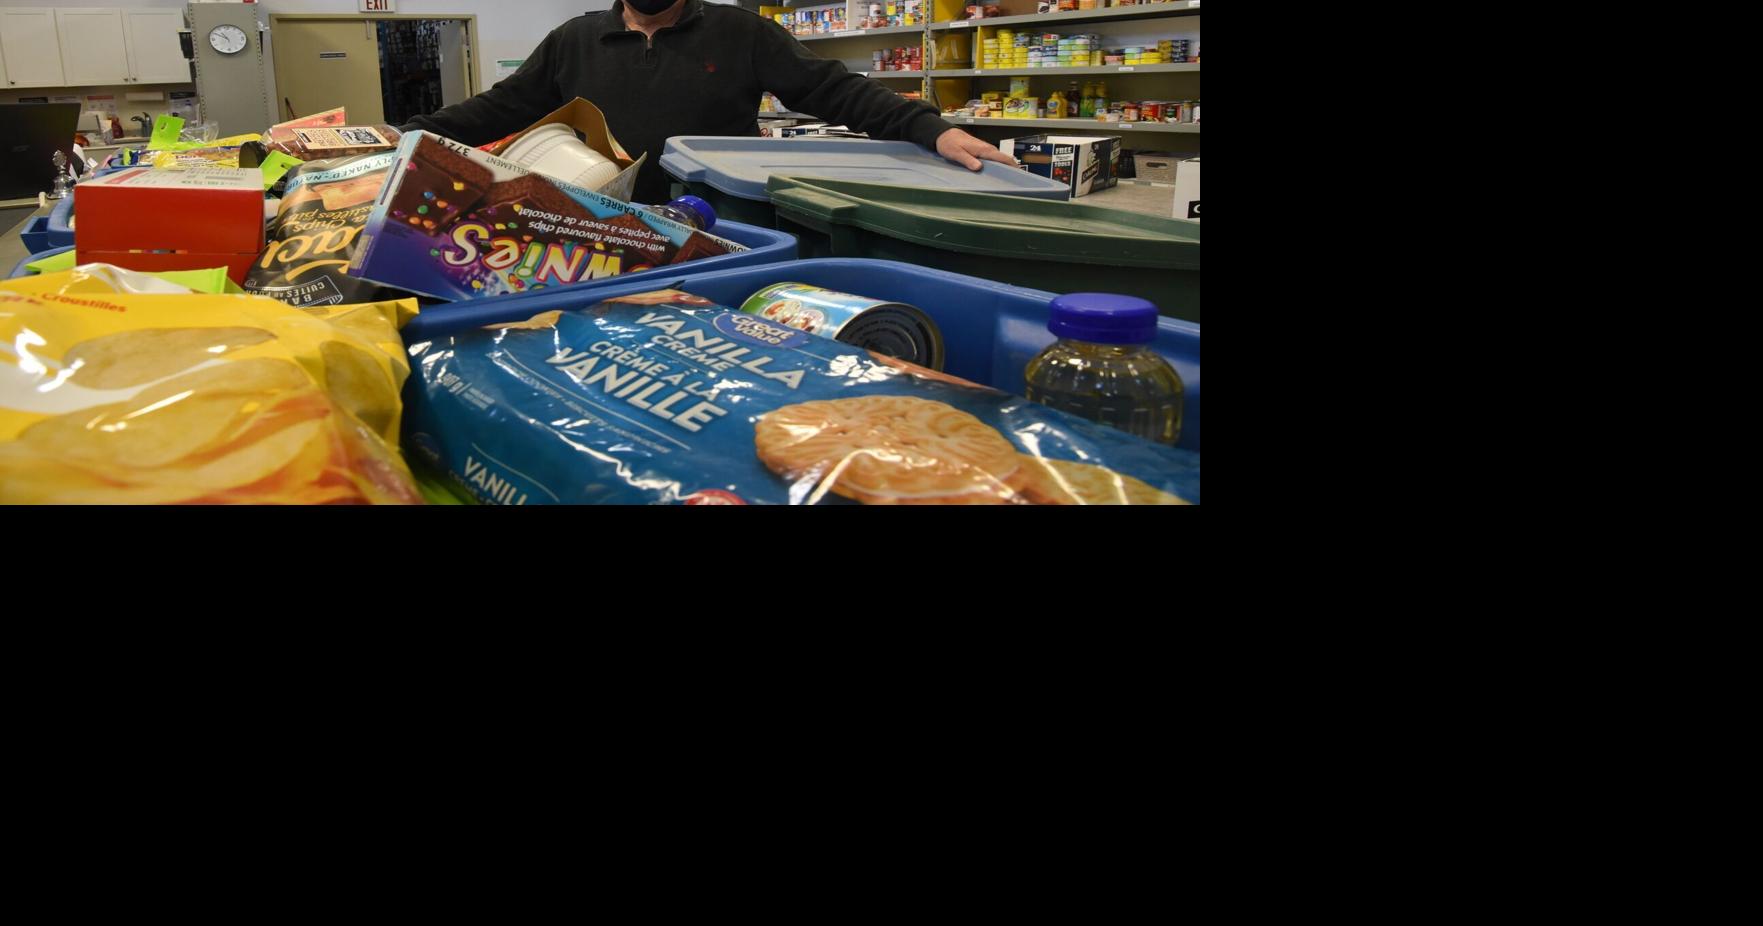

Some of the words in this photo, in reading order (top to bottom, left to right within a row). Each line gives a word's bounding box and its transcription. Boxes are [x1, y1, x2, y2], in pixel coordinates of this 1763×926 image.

[366, 0, 388, 10] EXIT
[446, 142, 470, 157] 372
[332, 163, 371, 179] NAKED
[518, 207, 562, 223] chocolat
[565, 216, 577, 226] de
[293, 218, 346, 232] Chips
[528, 220, 555, 233] chips
[578, 219, 609, 231] saveur
[556, 226, 602, 241] flavoured
[652, 233, 671, 242] avec
[603, 235, 646, 249] chocolate
[646, 243, 666, 252] with
[286, 281, 325, 298] CUITES
[41, 293, 127, 312] Croustilles
[731, 313, 795, 339] Great
[734, 323, 782, 344] Value
[635, 312, 805, 389] VANILLA
[651, 334, 735, 371] CREME
[545, 347, 728, 433] VANILLE
[684, 381, 721, 401] LA
